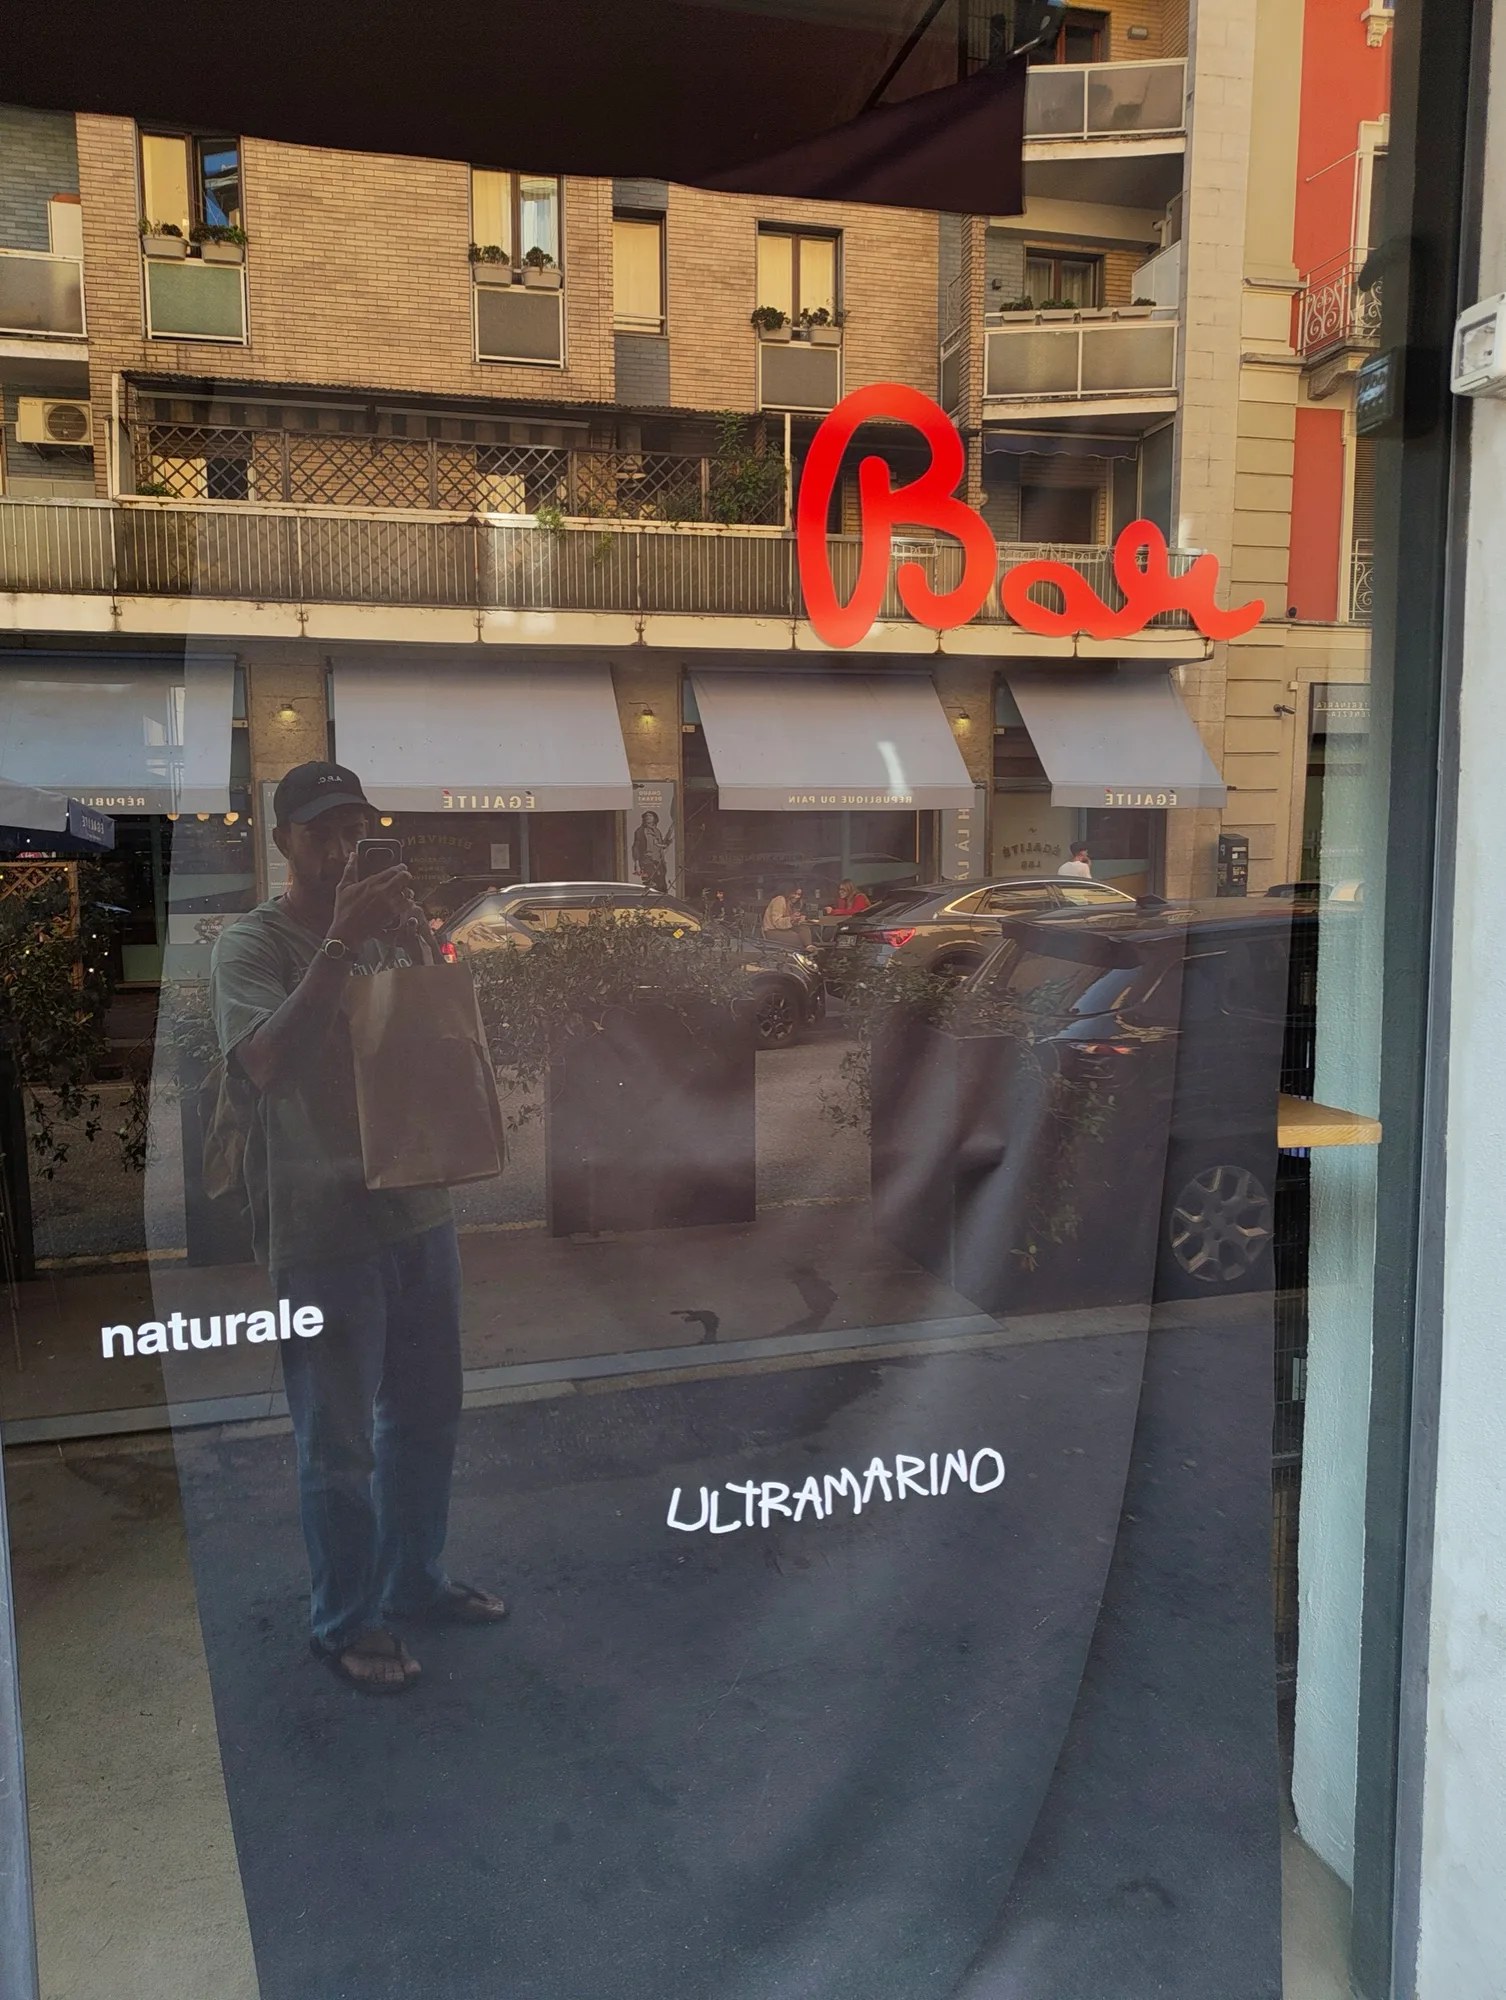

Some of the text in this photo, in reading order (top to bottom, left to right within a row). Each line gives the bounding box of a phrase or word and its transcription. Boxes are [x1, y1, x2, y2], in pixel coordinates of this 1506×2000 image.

[798, 383, 1265, 649] Bar
[101, 1298, 325, 1358] naturale
[667, 1447, 1006, 1534] ULTRAMARINO
